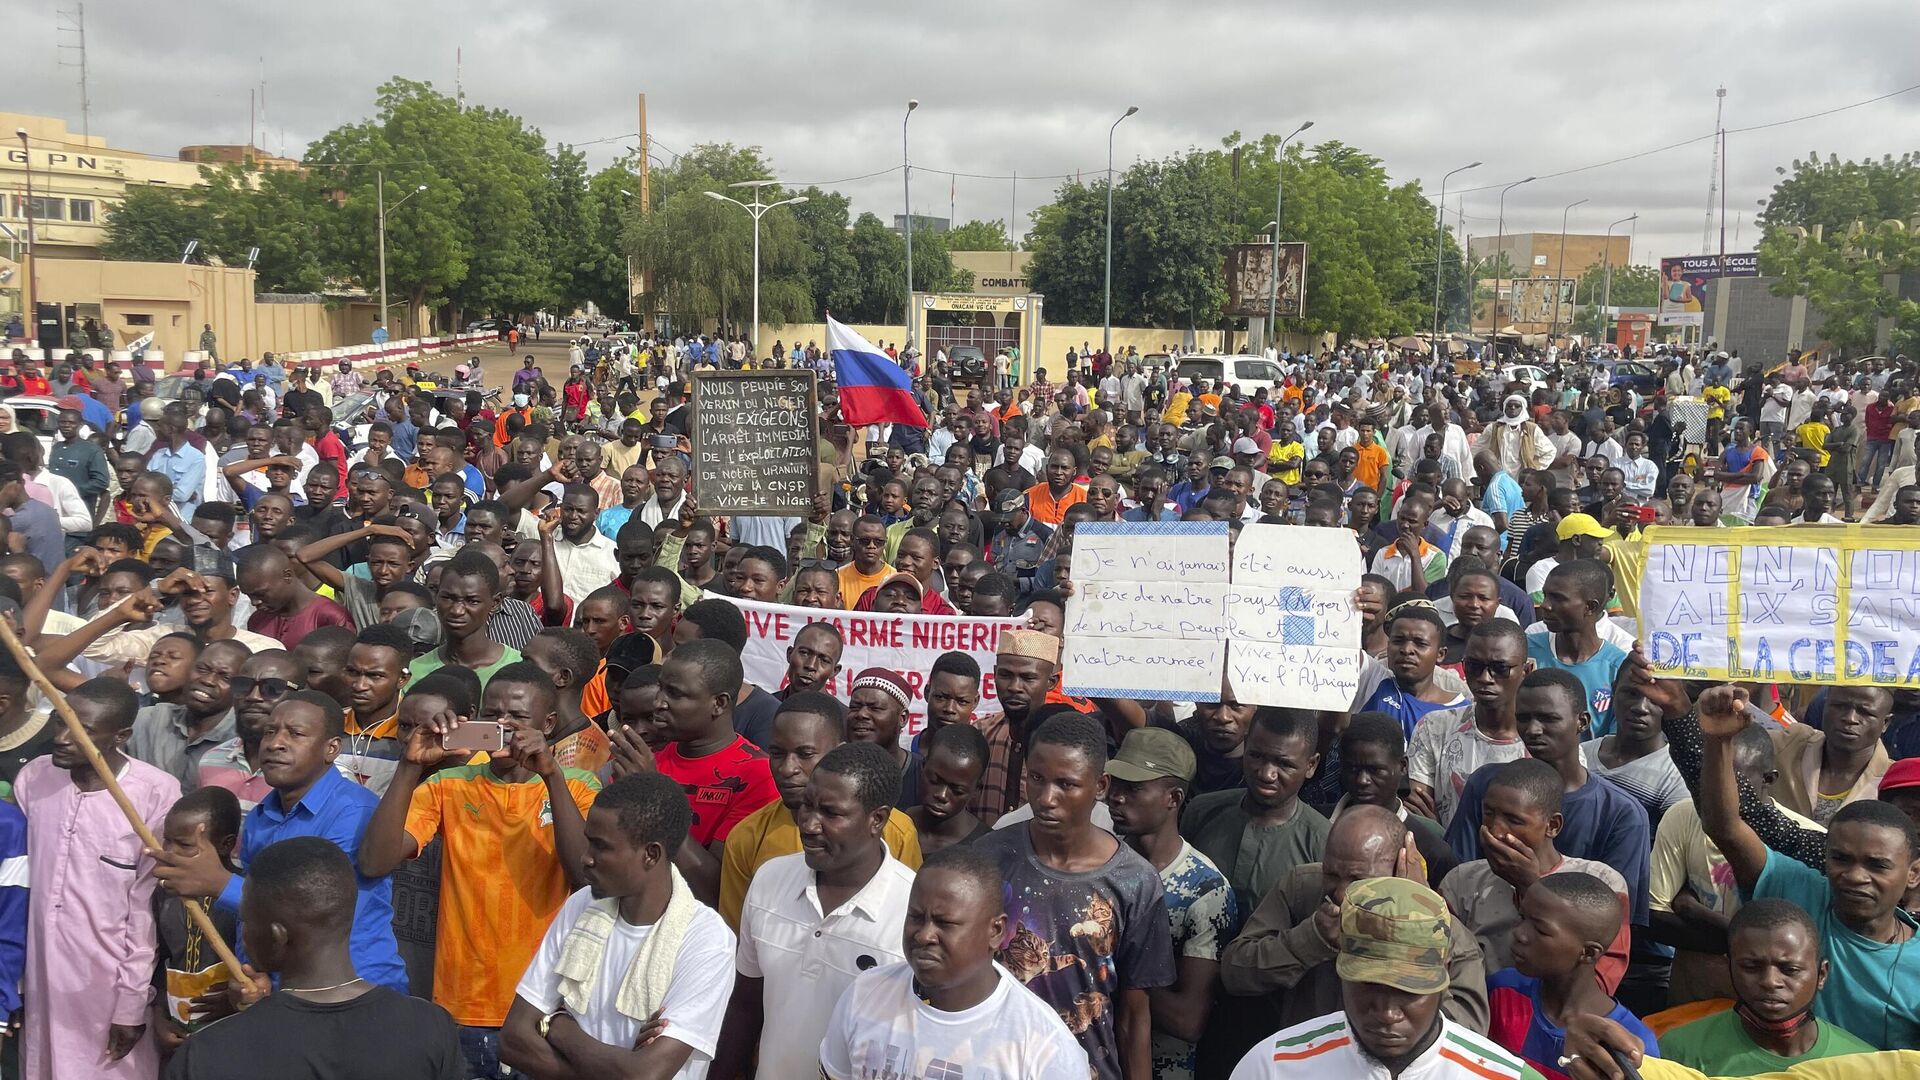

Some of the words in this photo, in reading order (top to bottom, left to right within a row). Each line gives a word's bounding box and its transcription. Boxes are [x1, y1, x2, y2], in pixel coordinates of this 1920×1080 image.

[1682, 259, 1708, 268] TOUS
[1709, 257, 1717, 267] À
[701, 381, 734, 396] NOUS
[699, 399, 740, 410] VERAIN
[745, 399, 758, 408] DU
[764, 396, 806, 410] NIGER
[701, 413, 731, 425] NOUS
[736, 410, 809, 428] EXIGEONS
[702, 452, 720, 462] DE
[702, 471, 717, 481] DE
[721, 482, 744, 493] VIVE
[751, 480, 762, 491] LA
[768, 481, 806, 492] CNSP
[717, 494, 749, 507] VIVE
[754, 493, 767, 505] LE
[776, 493, 812, 506] NIGER
[1080, 547, 1119, 576] Je
[1180, 559, 1227, 577] jamais
[1815, 547, 1920, 594] NO
[1134, 584, 1157, 602] de
[1160, 587, 1214, 606] notre
[1221, 593, 1280, 617] pays
[743, 610, 791, 641] IVE
[912, 621, 1024, 653] NIGERI
[1071, 612, 1089, 633] de
[1099, 612, 1173, 633] notre
[1179, 617, 1256, 643] peuple
[1266, 619, 1287, 638] et
[1317, 619, 1340, 639] de
[1072, 647, 1143, 667] notre
[1234, 644, 1272, 660] Vive
[1277, 645, 1299, 664] le
[1651, 632, 1709, 678] DE
[1727, 636, 1775, 680] LA
[1234, 664, 1270, 684] Vive
[700, 790, 727, 801] UNKUT
